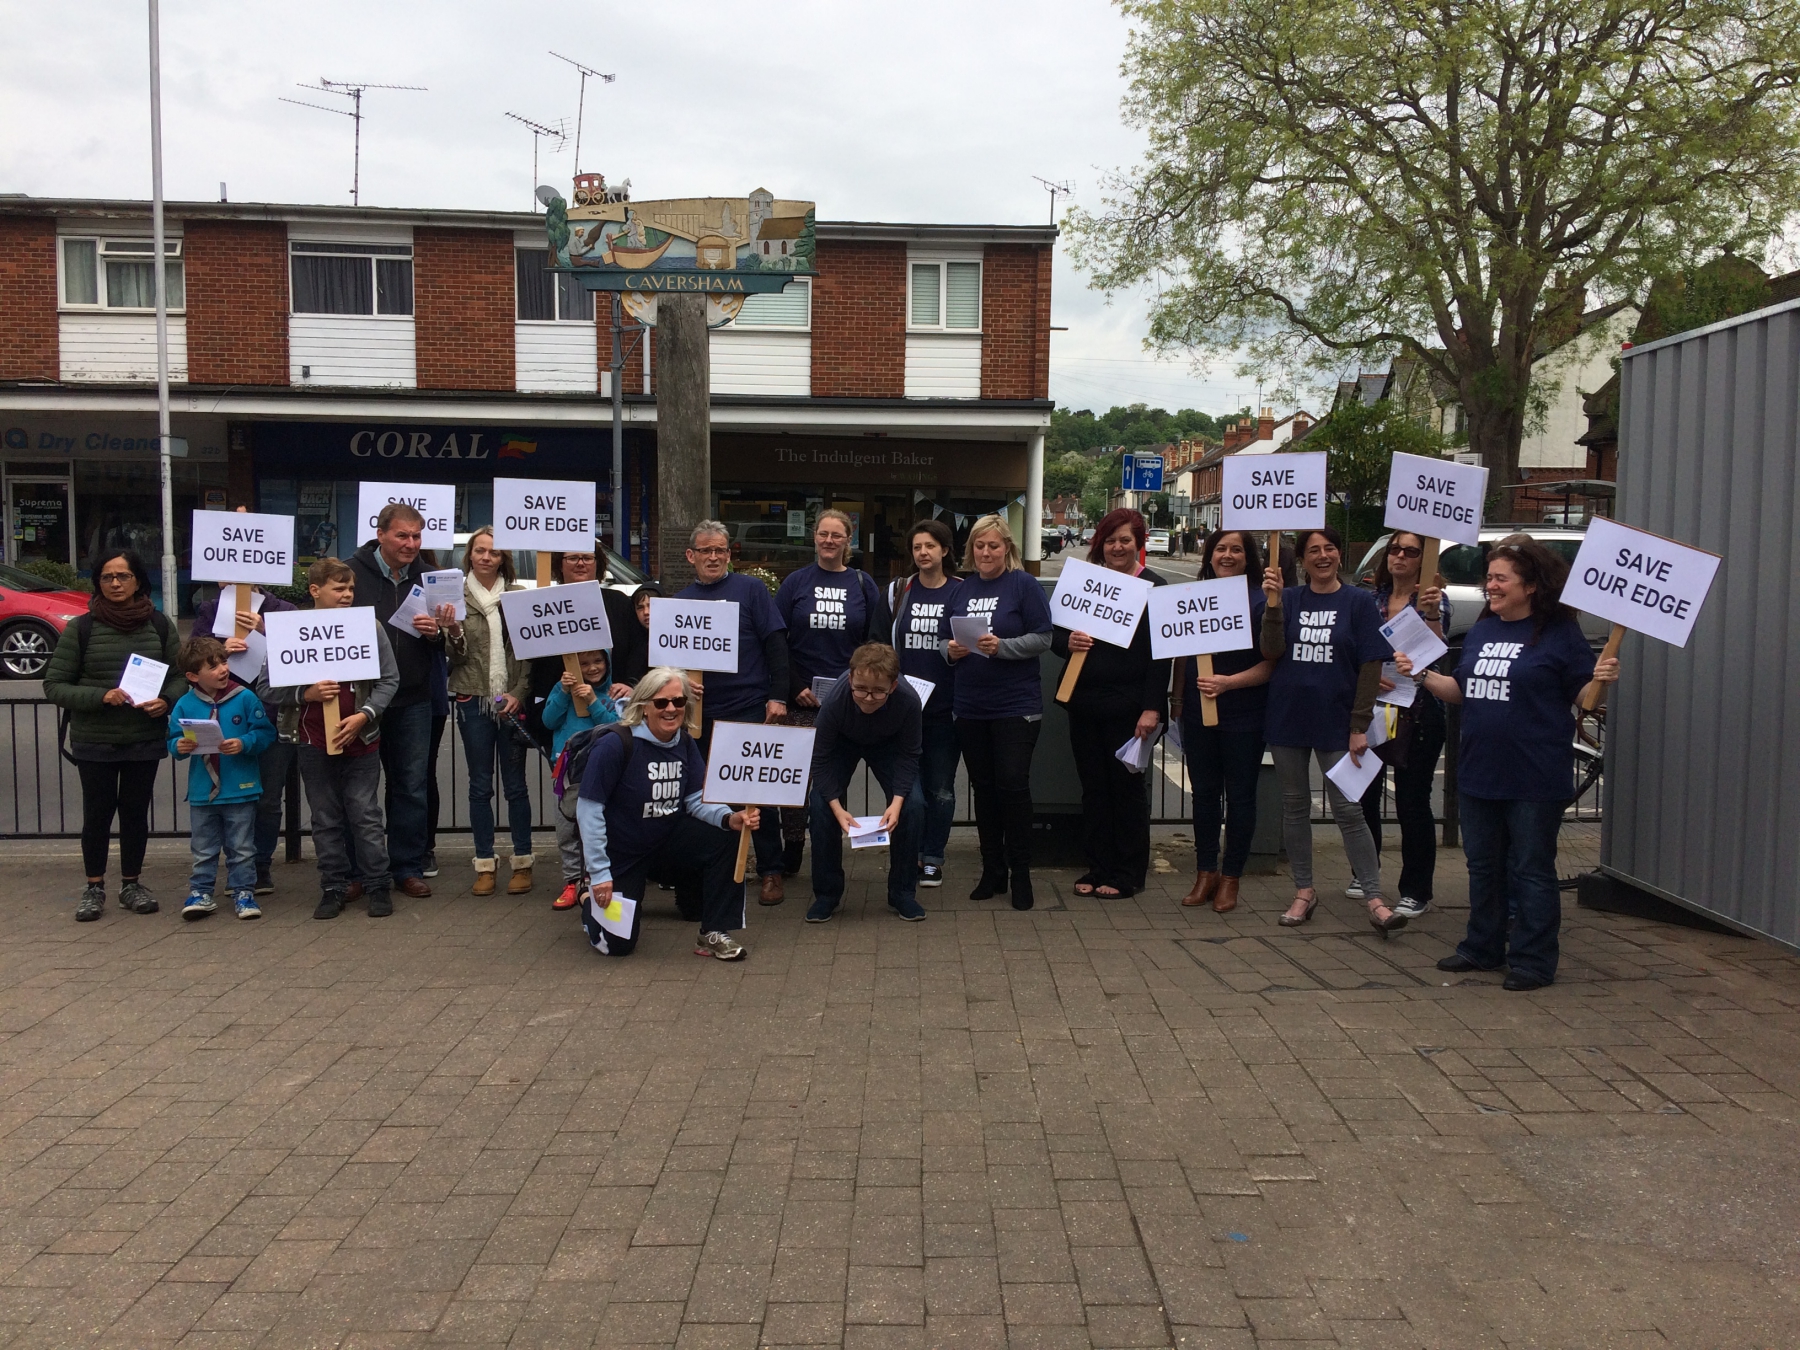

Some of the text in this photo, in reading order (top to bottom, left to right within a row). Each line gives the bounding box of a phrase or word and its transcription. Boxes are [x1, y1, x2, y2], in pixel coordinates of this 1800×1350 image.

[625, 275, 744, 291] CAVERSHAM
[38, 432, 77, 452] Dry
[350, 431, 489, 459] CORAL
[775, 448, 934, 467] The Indulgent Baker
[1251, 470, 1295, 487] SAVE
[1416, 474, 1456, 497] SAVE
[20, 499, 62, 508] Suprema
[300, 494, 330, 504] BACK
[524, 495, 566, 511] SAVE
[1232, 492, 1318, 510] OUR EDGE
[1397, 493, 1475, 524] OUR EDGE
[505, 516, 588, 532] OUR EDGE
[222, 527, 264, 543] SAVE
[204, 547, 286, 565] OUR EDGE
[1615, 548, 1673, 583] SAVE
[814, 586, 847, 600] SAVE
[1083, 579, 1121, 601] SAVE
[1583, 567, 1692, 620] OUR EDGE
[532, 600, 575, 617] SAVE
[816, 600, 844, 613] OUR
[911, 603, 944, 617] SAVE
[966, 597, 999, 611] SAVE
[1060, 594, 1134, 627] OUR EDGE
[1177, 596, 1219, 614] SAVE
[675, 614, 712, 630] SAVE
[809, 613, 847, 630] EDGE
[910, 618, 938, 632] OUR
[1161, 615, 1244, 638] OUR EDGE
[1299, 611, 1337, 626] SAVE
[299, 625, 344, 641] SAVE
[520, 617, 601, 640] OUR EDGE
[1299, 627, 1331, 644] OUR
[659, 634, 731, 652] OUR EDGE
[905, 633, 940, 650] EDGE
[281, 645, 370, 664] OUR EDGE
[1292, 643, 1333, 663] EDGE
[1478, 643, 1524, 659] SAVE
[1473, 659, 1512, 677] OUR
[1465, 678, 1511, 701] EDGE
[741, 741, 784, 759] SAVE
[647, 761, 683, 780] SAVE
[719, 765, 802, 784] OUR EDGE
[652, 781, 680, 800] OUR
[643, 799, 680, 818] EDGE
